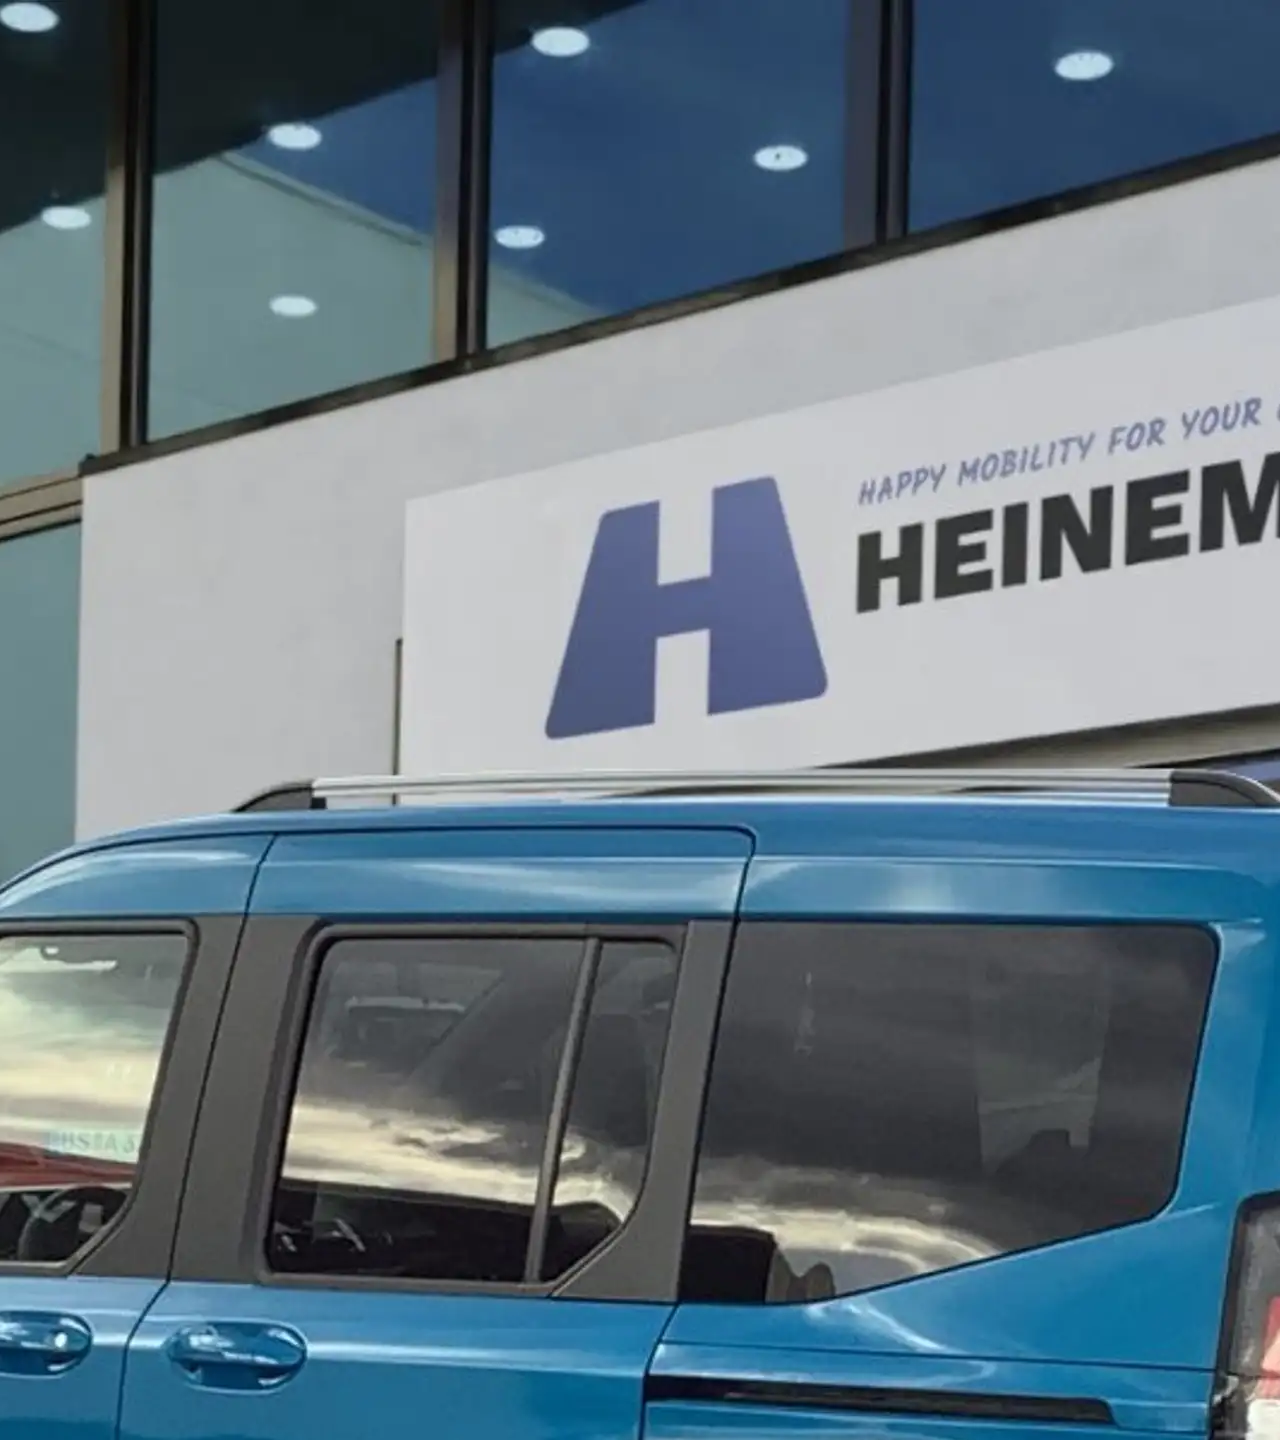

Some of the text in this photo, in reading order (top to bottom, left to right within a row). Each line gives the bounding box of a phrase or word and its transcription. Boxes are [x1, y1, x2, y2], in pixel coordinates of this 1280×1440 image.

[858, 463, 947, 506] HAPPY
[957, 432, 1096, 487] MOBILITY
[1107, 417, 1167, 455] FOR
[1181, 397, 1263, 441] YOUR
